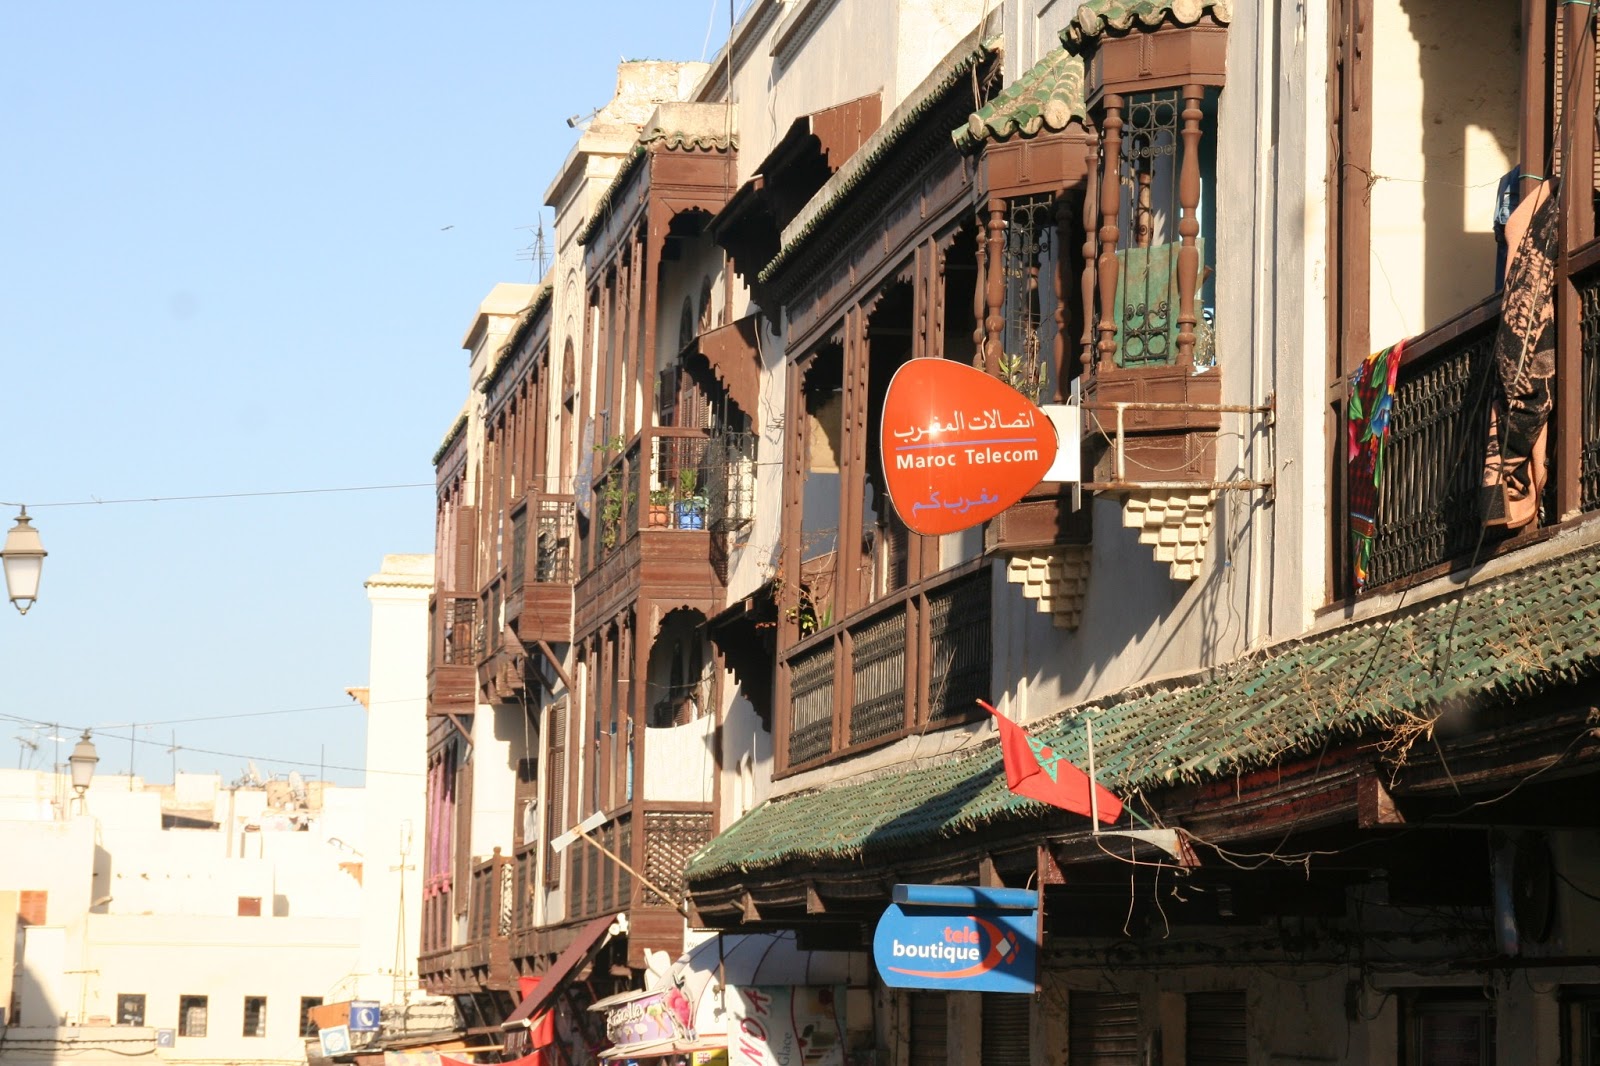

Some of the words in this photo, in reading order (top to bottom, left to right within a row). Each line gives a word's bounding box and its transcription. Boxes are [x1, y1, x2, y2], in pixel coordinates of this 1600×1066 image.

[894, 411, 965, 443] المغرب
[968, 409, 1035, 431] اتصالات
[896, 452, 956, 470] Maroc
[964, 447, 1038, 465] Telecom
[944, 926, 980, 944] tele
[893, 939, 980, 964] boutique
